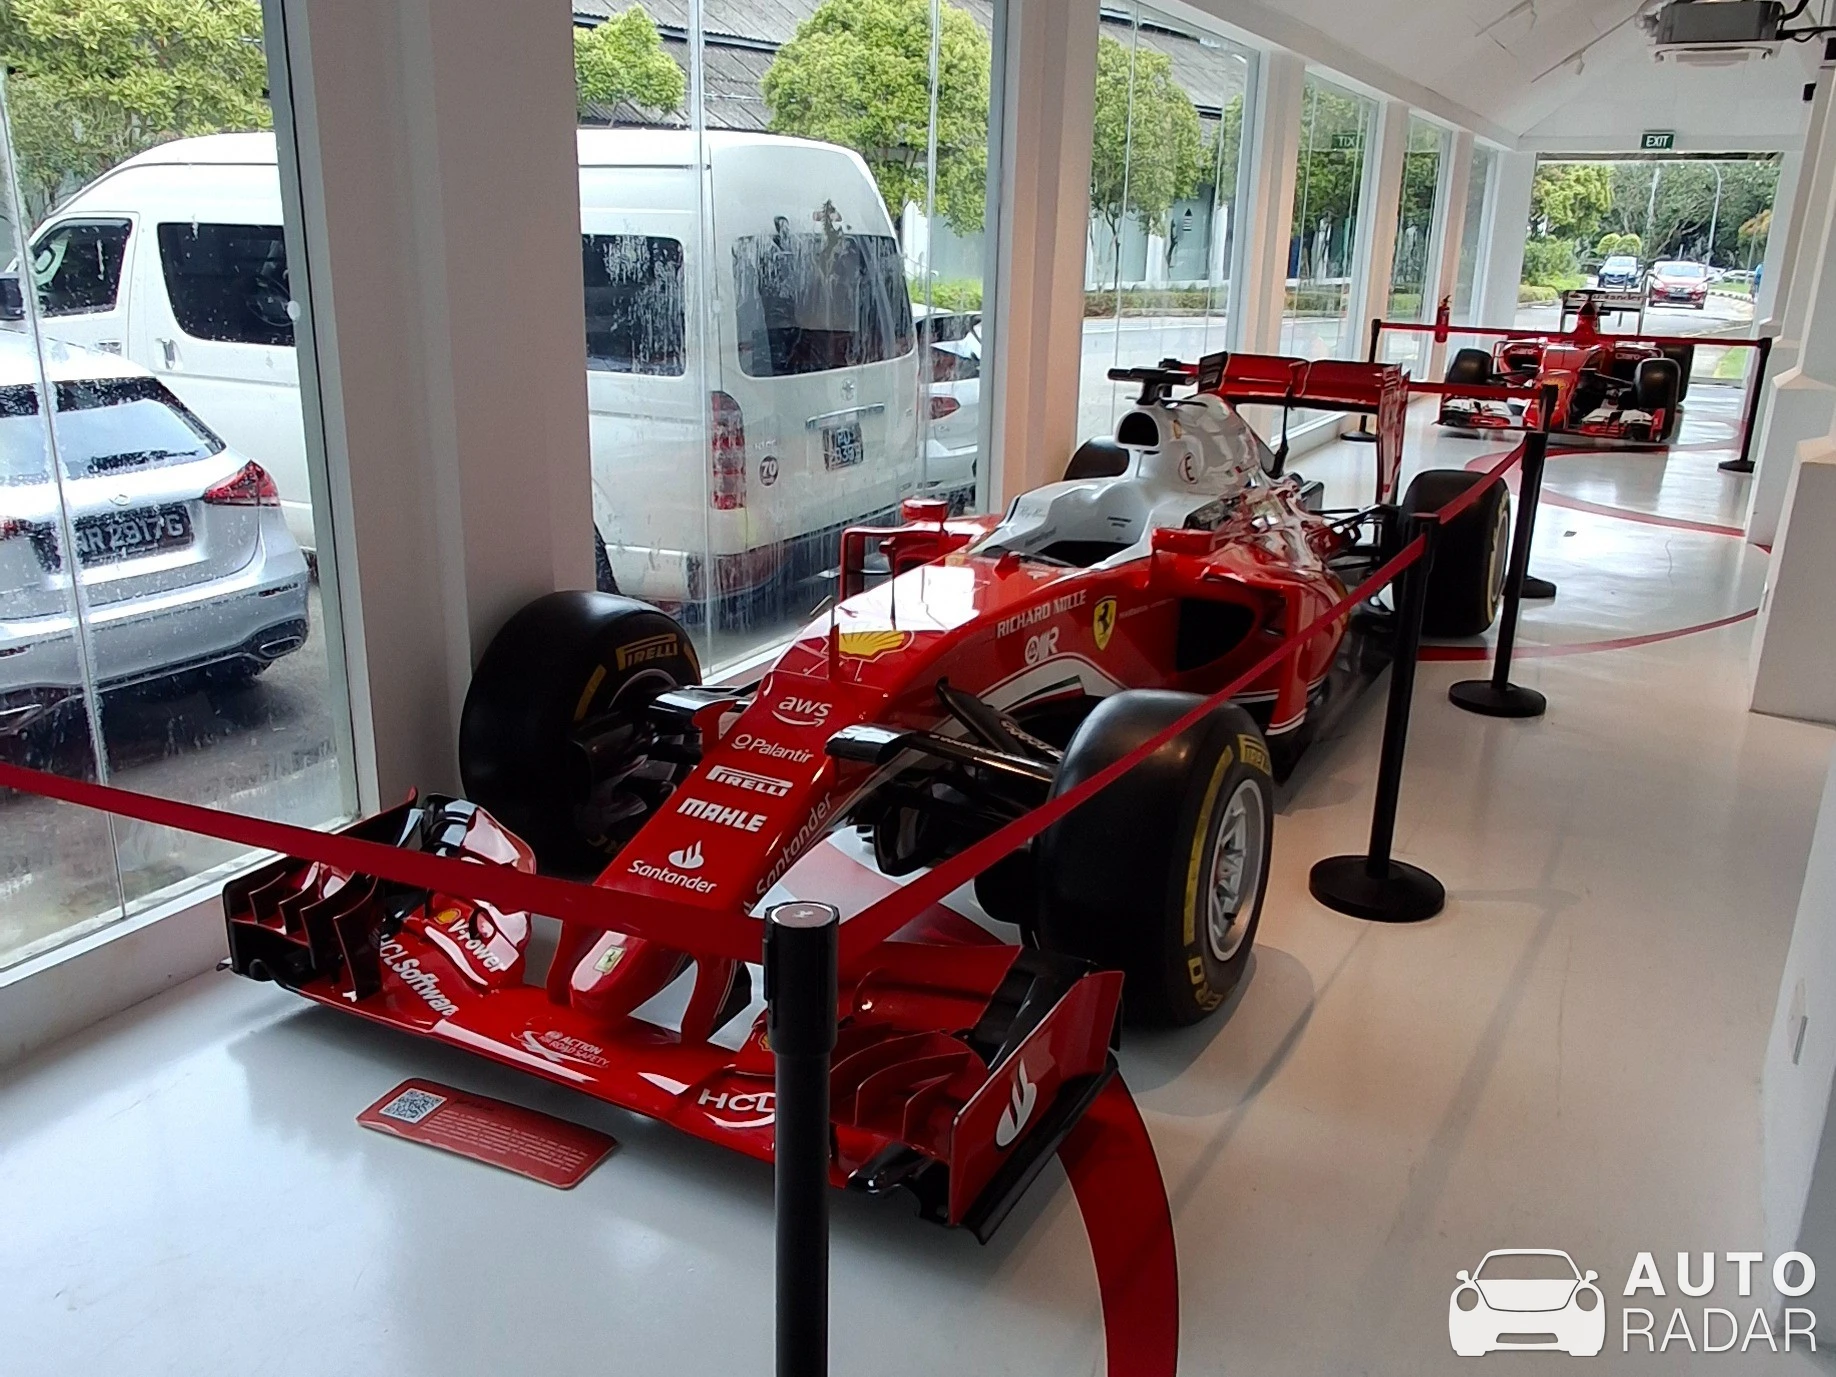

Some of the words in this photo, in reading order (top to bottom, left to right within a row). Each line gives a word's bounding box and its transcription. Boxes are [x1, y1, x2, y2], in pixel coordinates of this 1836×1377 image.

[1646, 135, 1670, 148] EXIT
[762, 460, 776, 477] 70
[996, 602, 1051, 638] RICHARD
[1052, 589, 1087, 615] MILLE
[615, 632, 679, 671] PIRELLI
[779, 696, 833, 718] aws
[750, 737, 814, 763] Palantir
[705, 764, 794, 797] PIRELLI
[677, 797, 768, 833] MAHLE
[756, 792, 833, 895] Santander
[627, 859, 718, 894] Santander
[558, 1036, 604, 1055] ACTION
[574, 1049, 611, 1066] SAFETY
